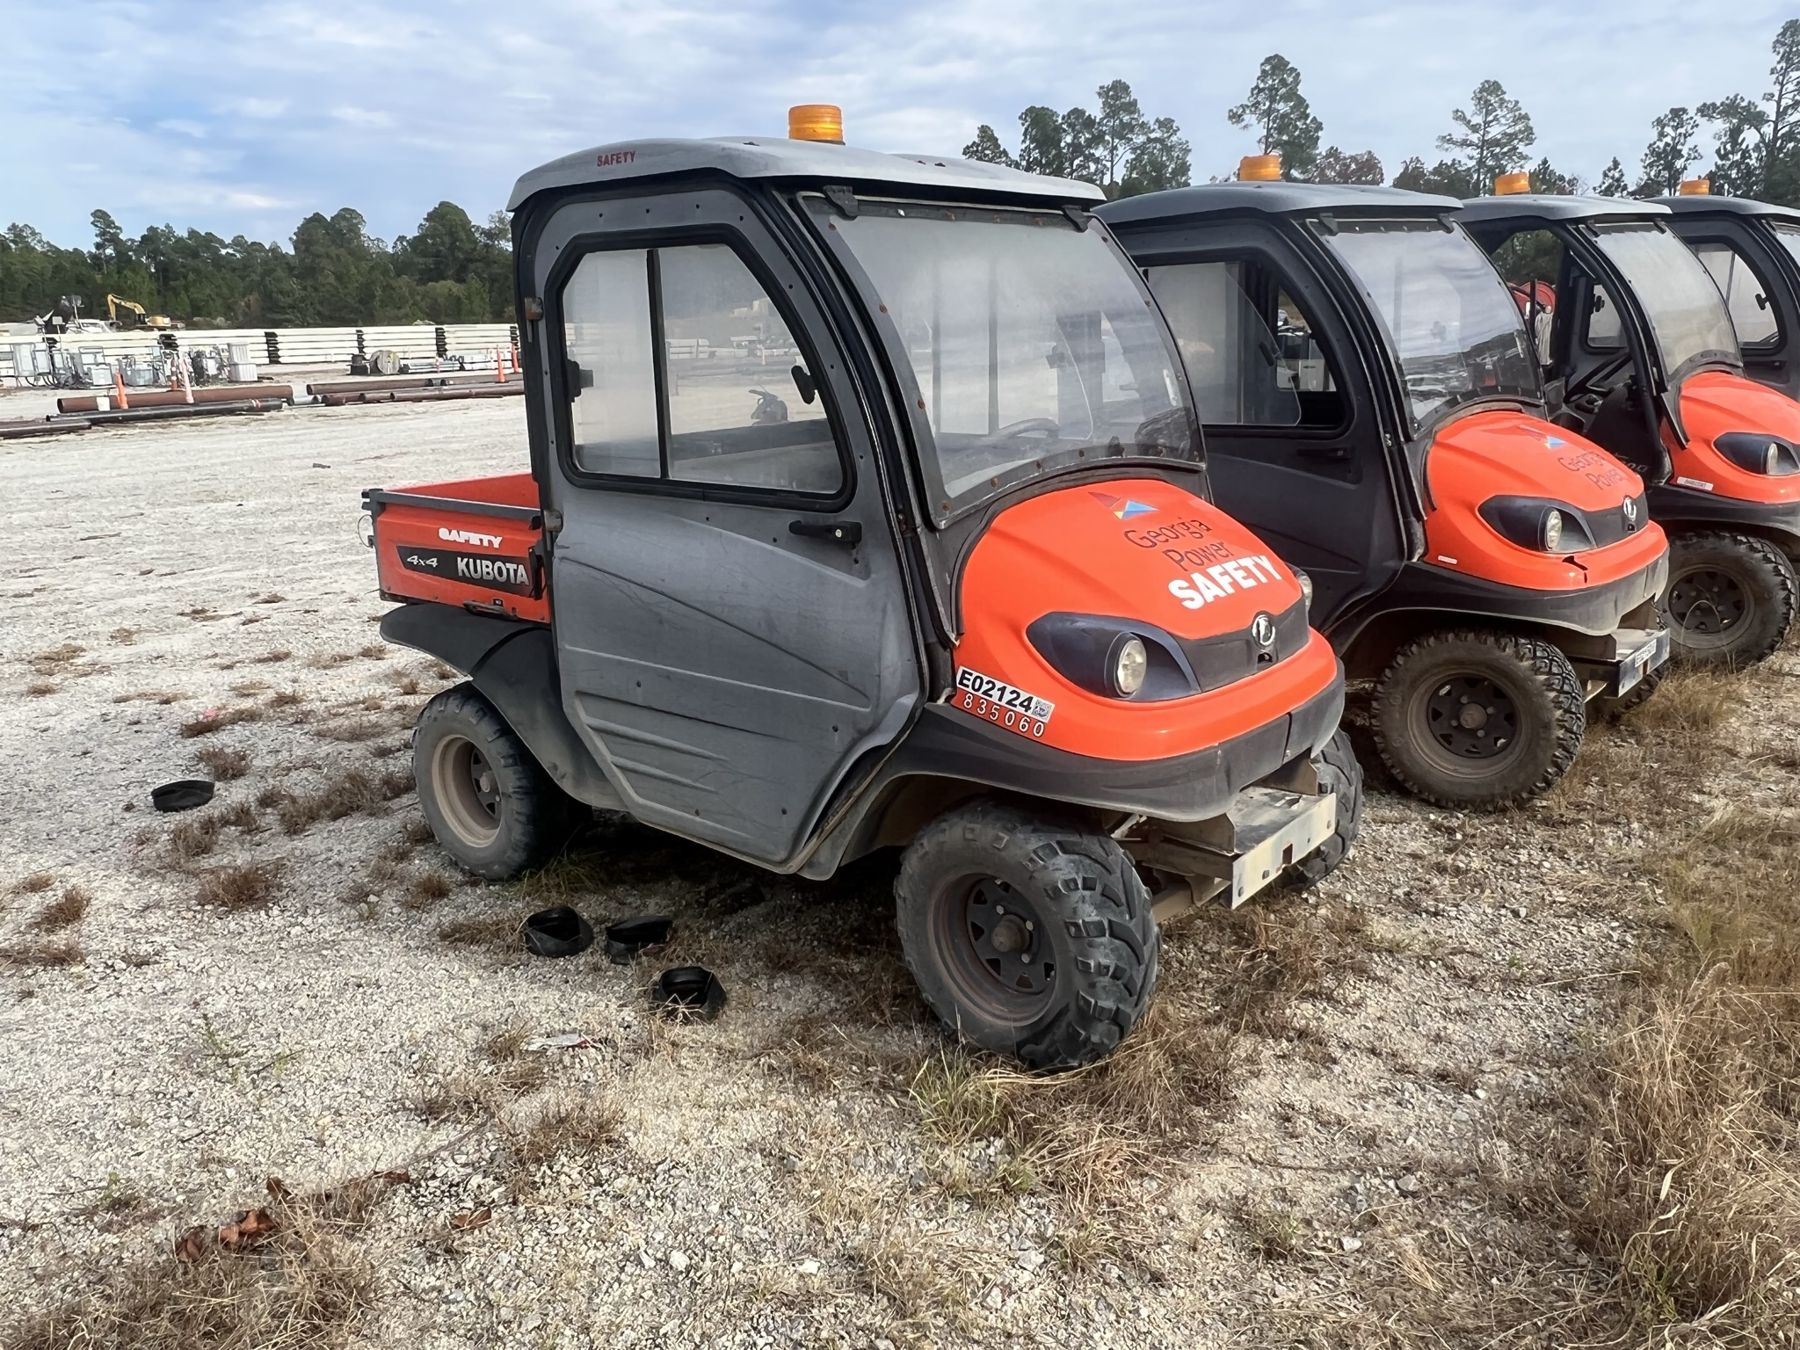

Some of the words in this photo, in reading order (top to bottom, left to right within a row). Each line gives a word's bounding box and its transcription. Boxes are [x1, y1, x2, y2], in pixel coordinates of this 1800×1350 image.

[597, 151, 636, 167] SAFETY
[438, 527, 503, 549] SAFETY
[1124, 517, 1212, 549] Georgia
[406, 555, 439, 568] 4x4
[456, 556, 530, 586] KUBOTA
[1162, 541, 1234, 572] Power
[1168, 555, 1282, 610] SAFETY
[957, 669, 1034, 713] E02124
[963, 693, 1045, 737] 835060
